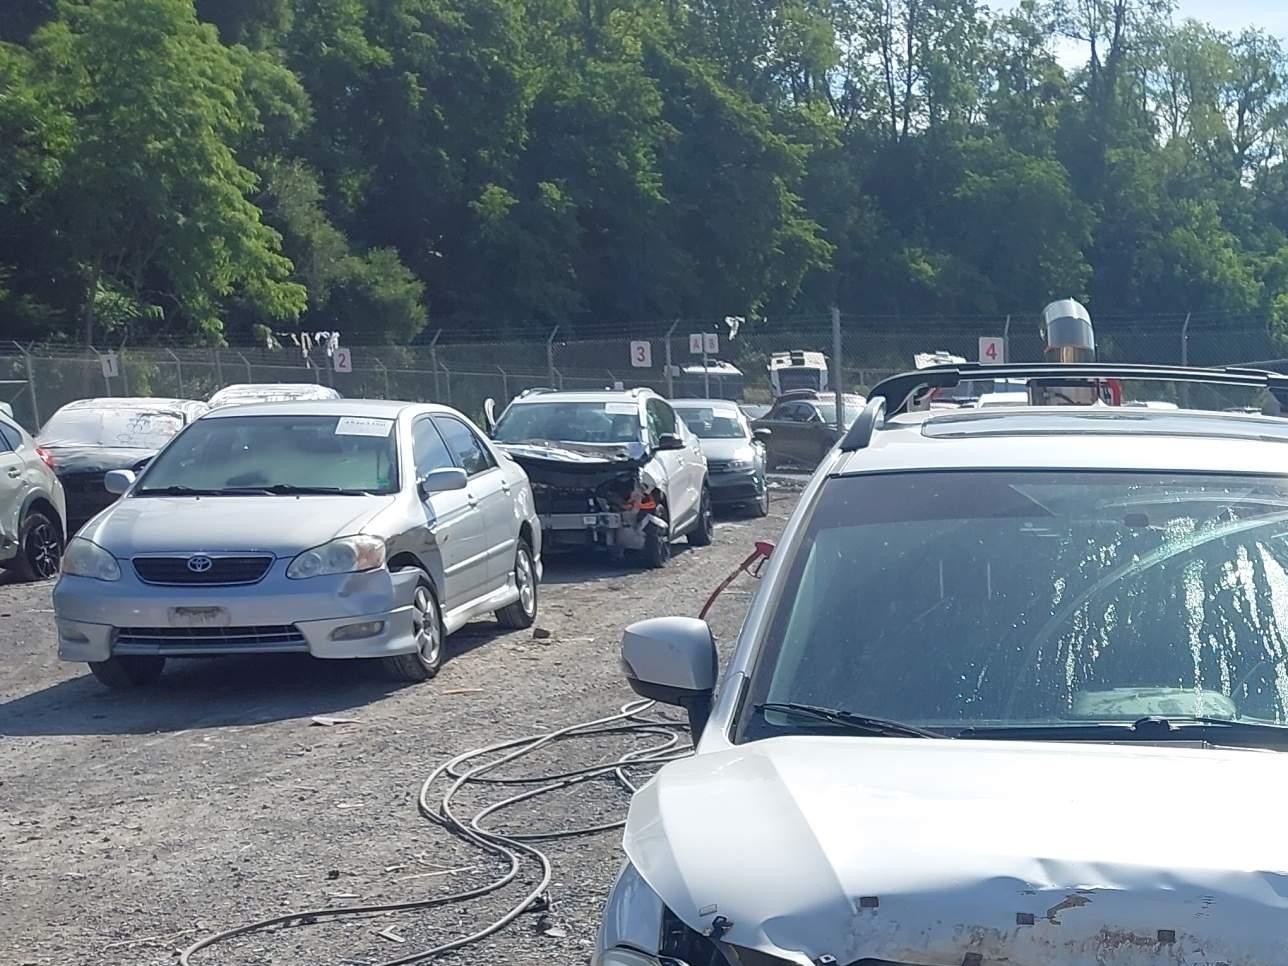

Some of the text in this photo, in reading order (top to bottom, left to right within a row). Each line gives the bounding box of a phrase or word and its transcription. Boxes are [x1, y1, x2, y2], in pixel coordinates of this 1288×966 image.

[636, 346, 646, 362] 3
[985, 342, 998, 360] 4
[338, 353, 347, 368] 2
